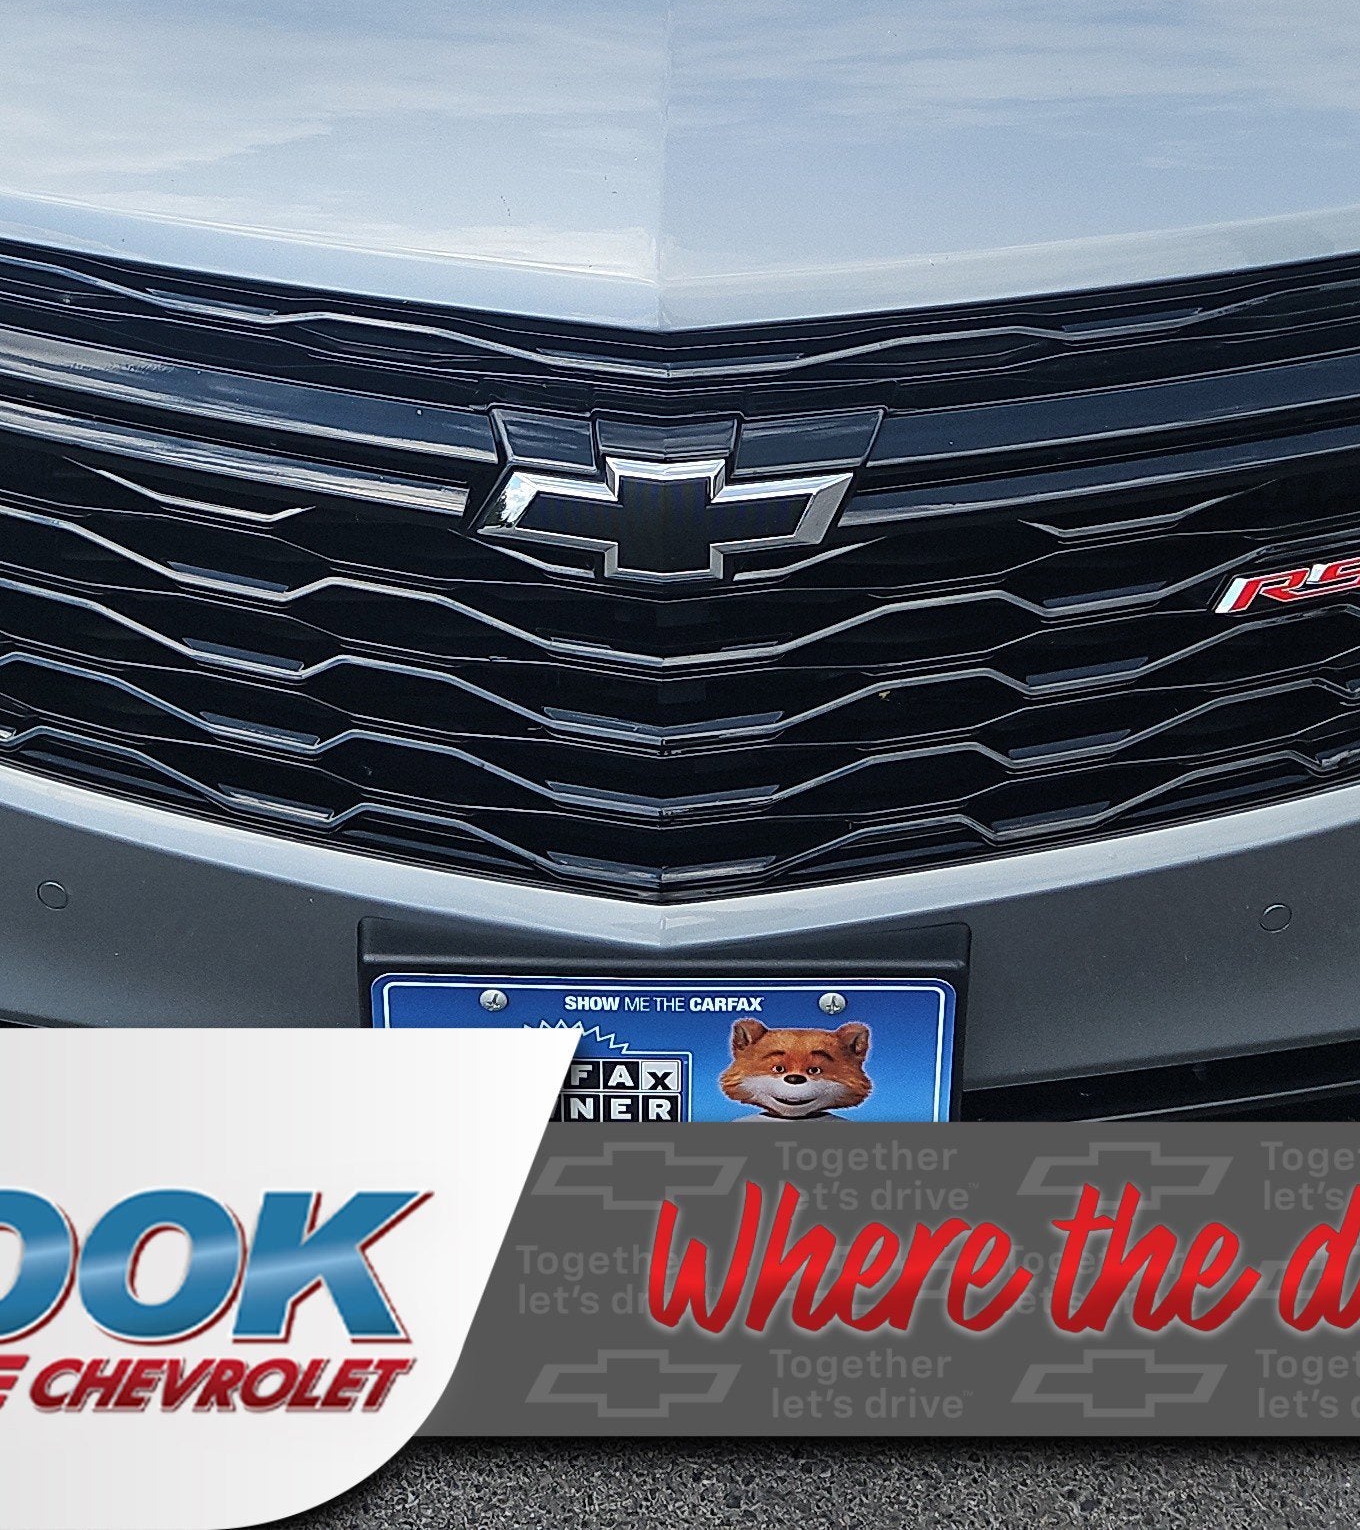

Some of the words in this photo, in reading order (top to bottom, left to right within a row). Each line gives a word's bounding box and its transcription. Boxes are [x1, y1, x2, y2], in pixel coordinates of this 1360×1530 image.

[565, 996, 619, 1011] SHOW
[625, 997, 650, 1011] ME
[653, 997, 685, 1012] THE
[690, 997, 763, 1012] CARFAX
[570, 1064, 675, 1090] FAX
[569, 1097, 672, 1120] NER
